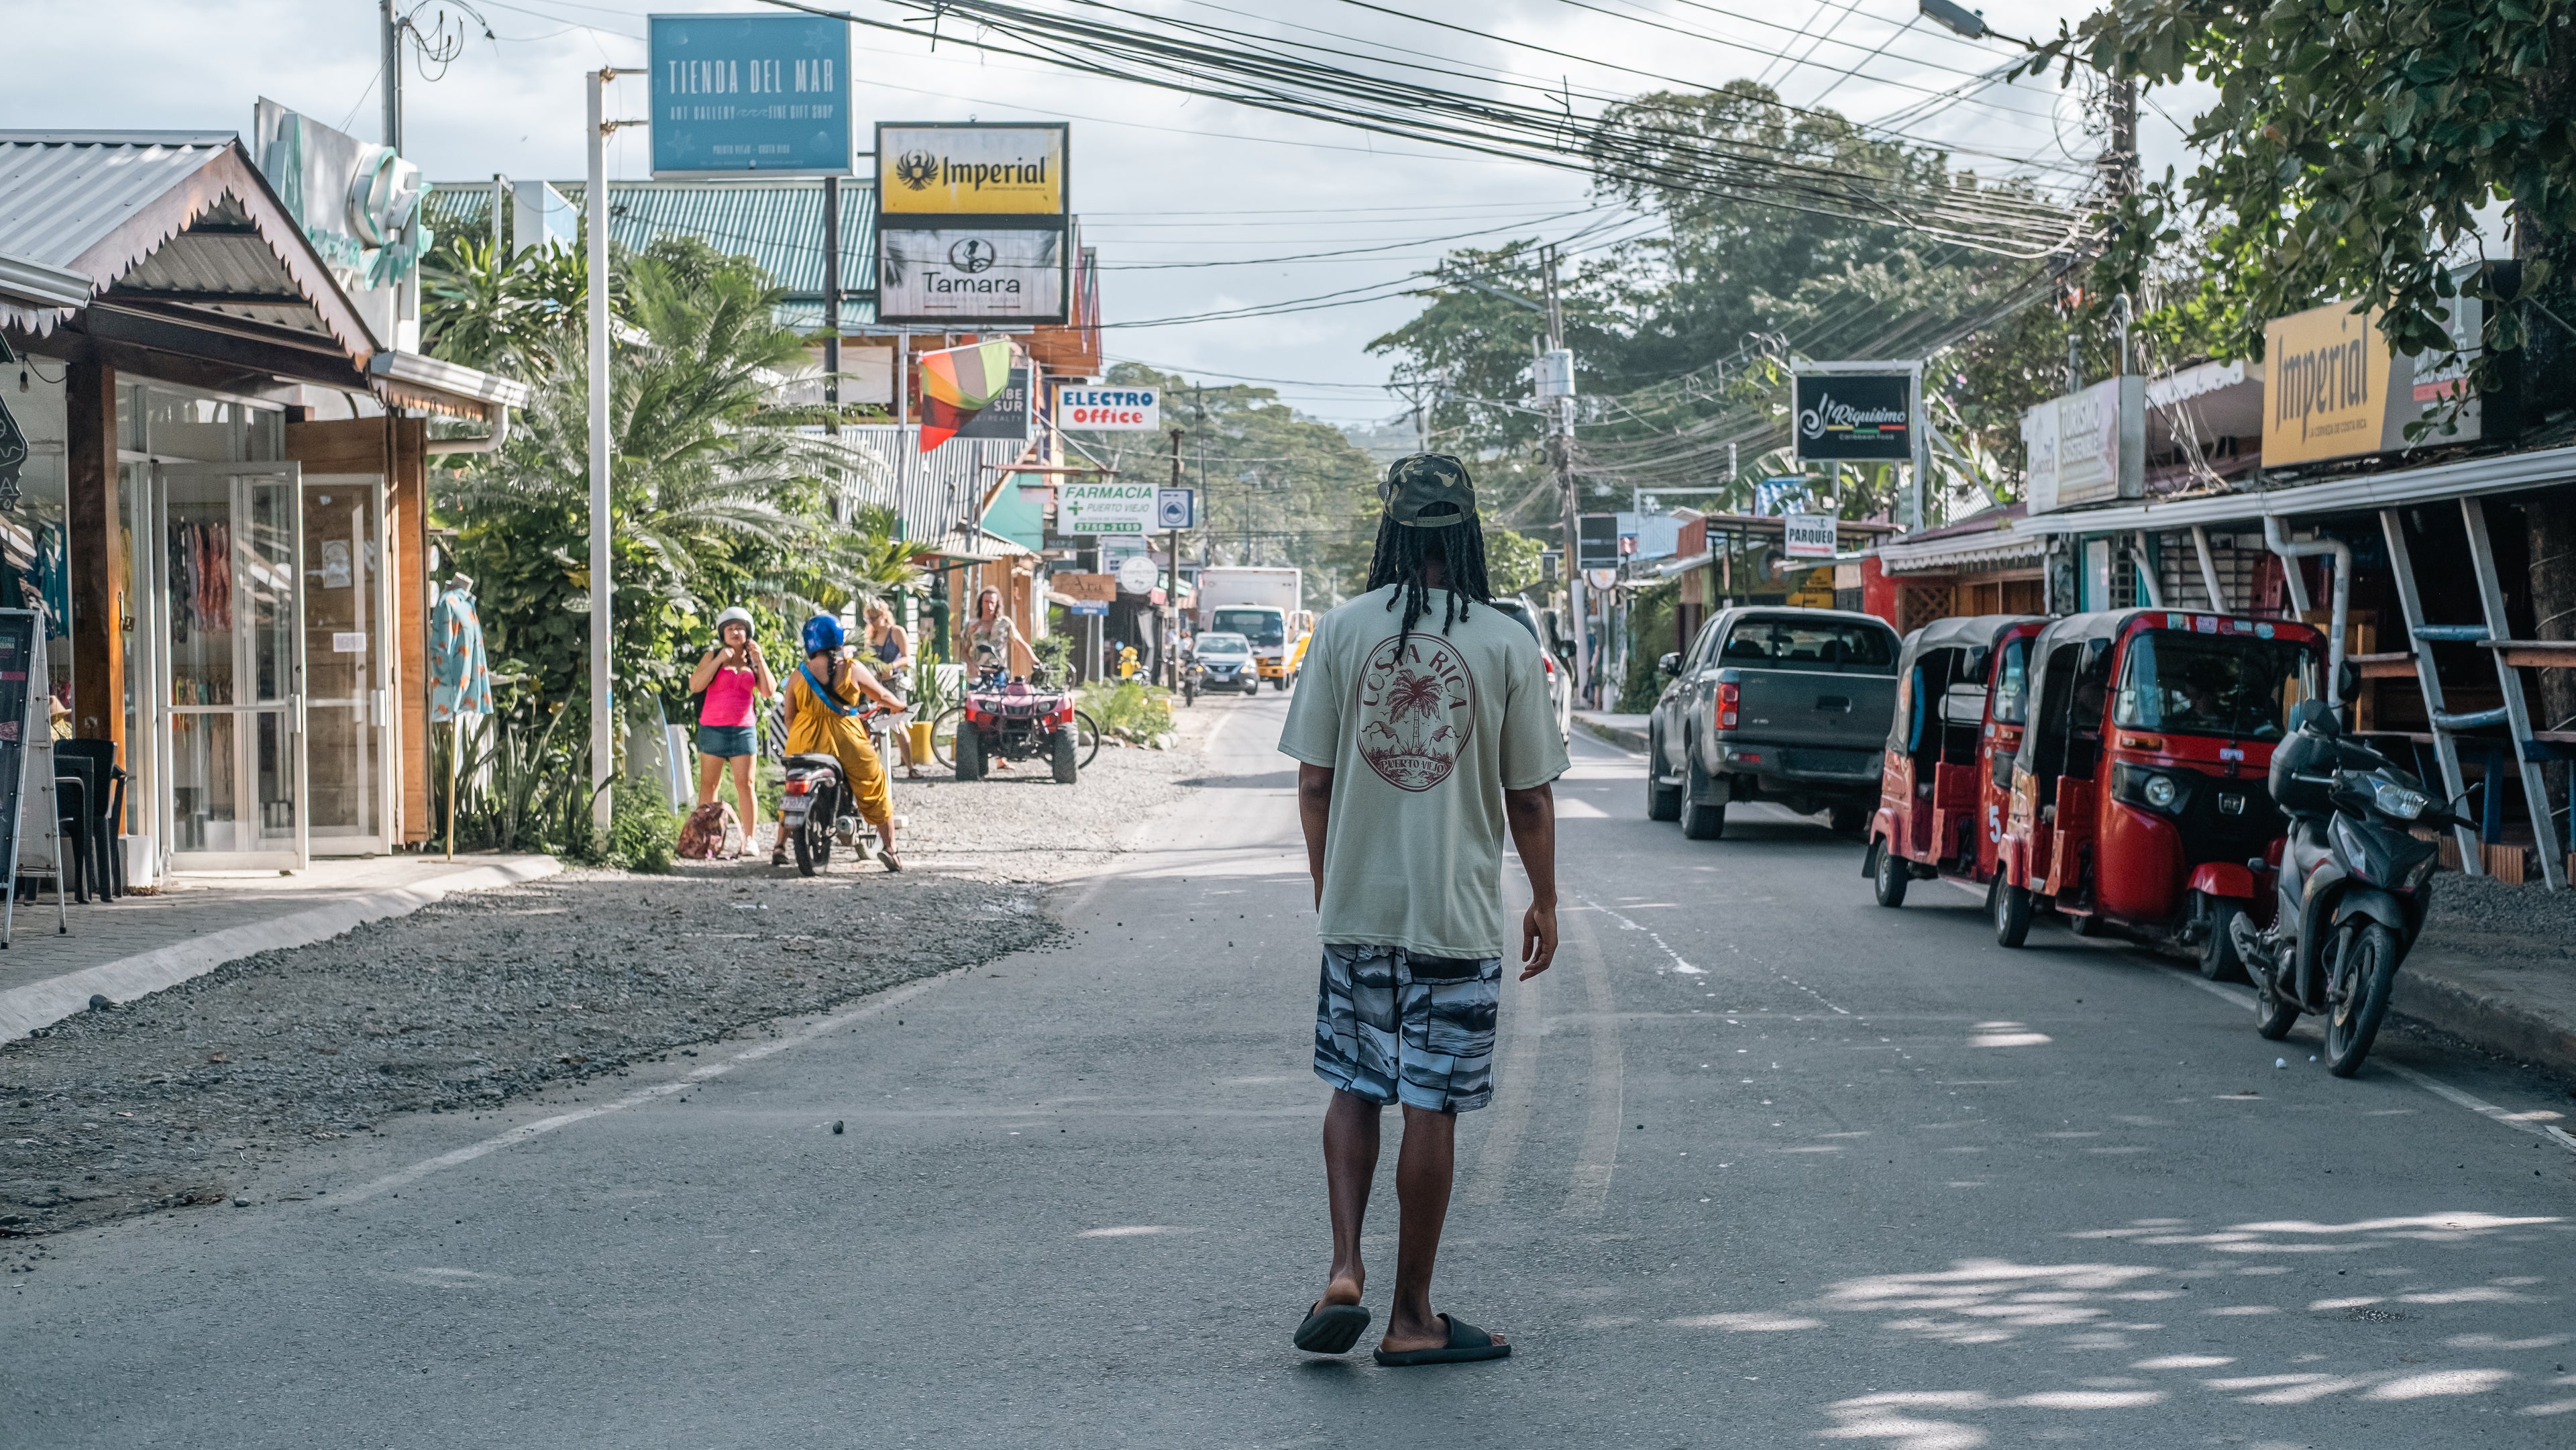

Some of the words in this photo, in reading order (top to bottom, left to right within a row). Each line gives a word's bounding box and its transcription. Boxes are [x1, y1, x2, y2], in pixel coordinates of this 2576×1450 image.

[669, 59, 739, 95] TIENDA
[750, 59, 783, 94] DEL
[795, 58, 834, 93] MAR
[694, 105, 736, 121] GALLERY
[769, 105, 787, 119] FINE
[790, 105, 809, 119] GIFT
[812, 104, 834, 119] SHOP
[943, 156, 1046, 192] Imperial
[922, 271, 1020, 294] Tamara
[2275, 314, 2368, 446] Imperial
[994, 400, 1024, 412] SUR
[1063, 391, 1153, 407] ELECTRO
[1073, 408, 1143, 423] Office
[1831, 404, 1907, 428] Riquísimo
[2060, 395, 2100, 439] TURISMO
[1065, 486, 1152, 499] FARMACIA
[1086, 503, 1122, 513] PUERTO
[1124, 503, 1150, 513] VIEJO
[1788, 528, 1833, 544] PARQUEO
[1362, 643, 1421, 707] COSTA
[1428, 650, 1467, 710] RICA
[1380, 758, 1420, 771] PUERTO
[1421, 761, 1446, 773] VIEJO
[1989, 805, 2002, 843] 5
